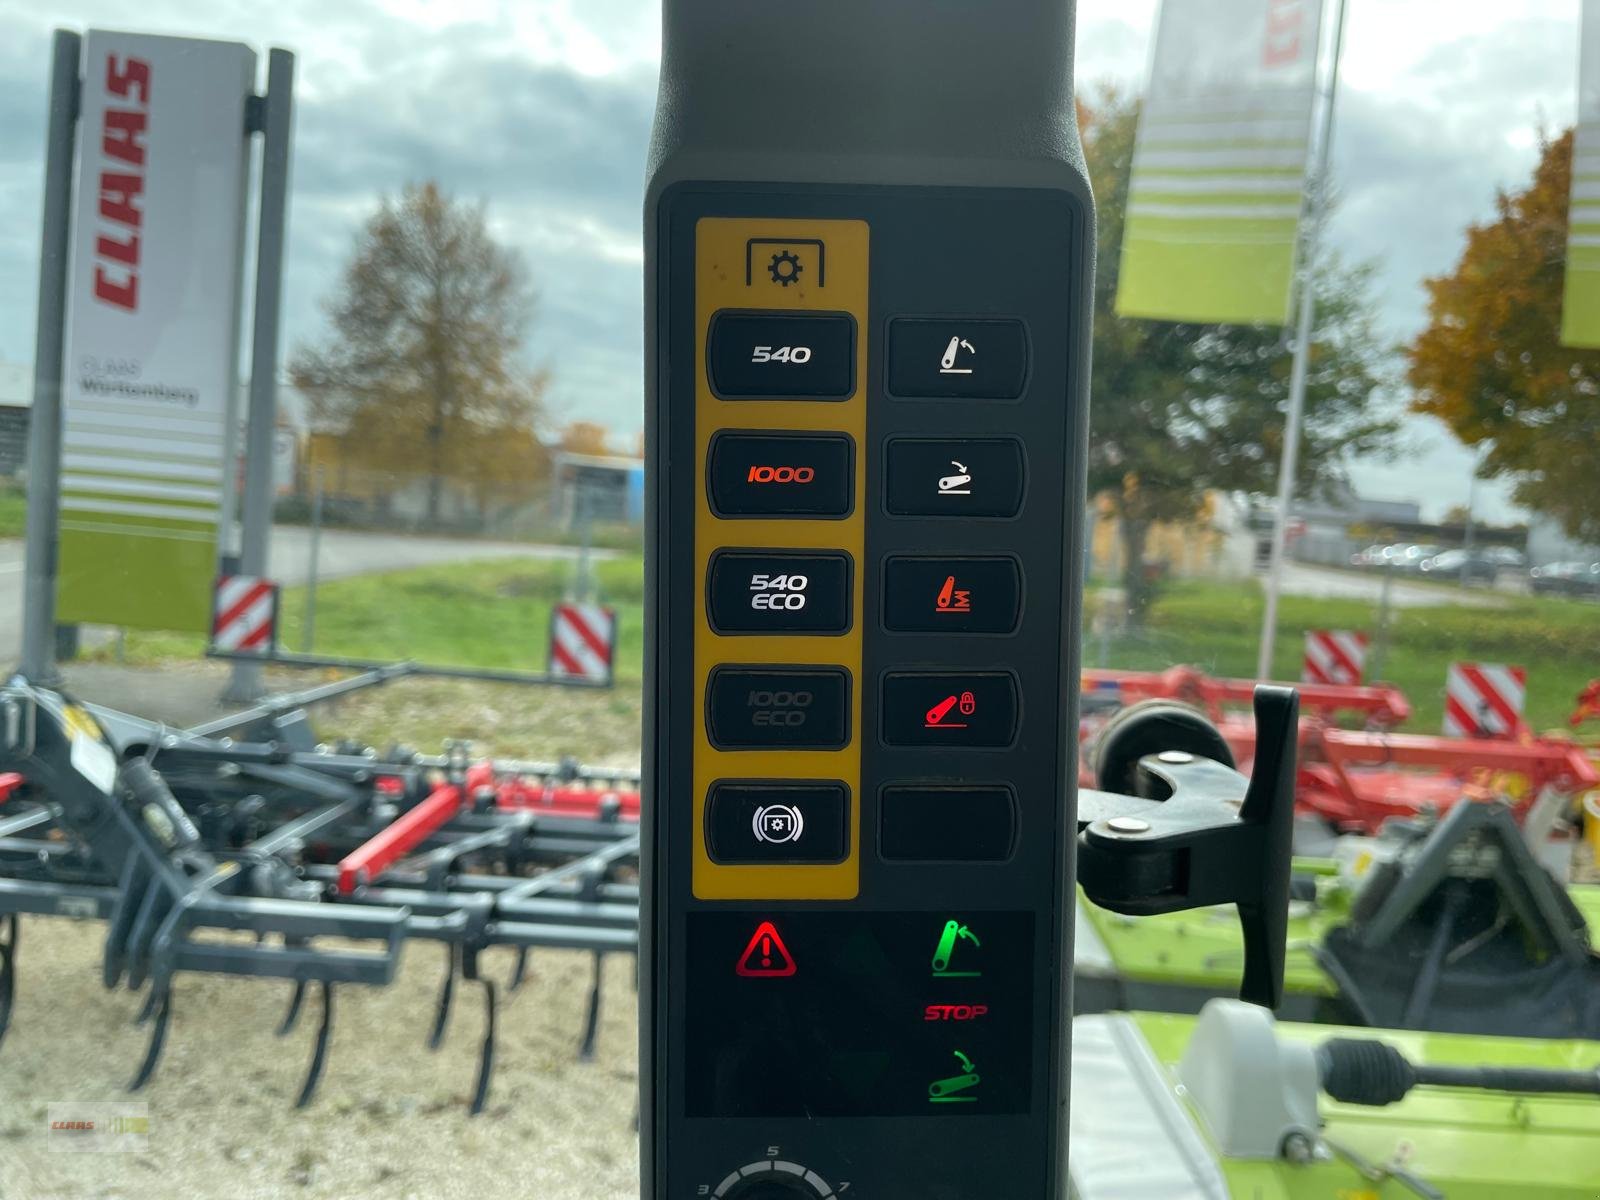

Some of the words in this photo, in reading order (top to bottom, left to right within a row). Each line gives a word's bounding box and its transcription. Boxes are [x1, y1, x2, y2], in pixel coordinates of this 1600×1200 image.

[93, 53, 152, 313] CLAAS
[751, 346, 811, 363] 540
[748, 466, 815, 484] 1000
[750, 575, 808, 591] 540
[751, 594, 806, 610] ECO
[748, 691, 813, 707] 1000
[751, 710, 806, 727] ECO
[924, 1005, 988, 1021] STOP
[766, 1146, 780, 1156] 5
[697, 1184, 710, 1195] 3
[838, 1182, 850, 1192] 7
